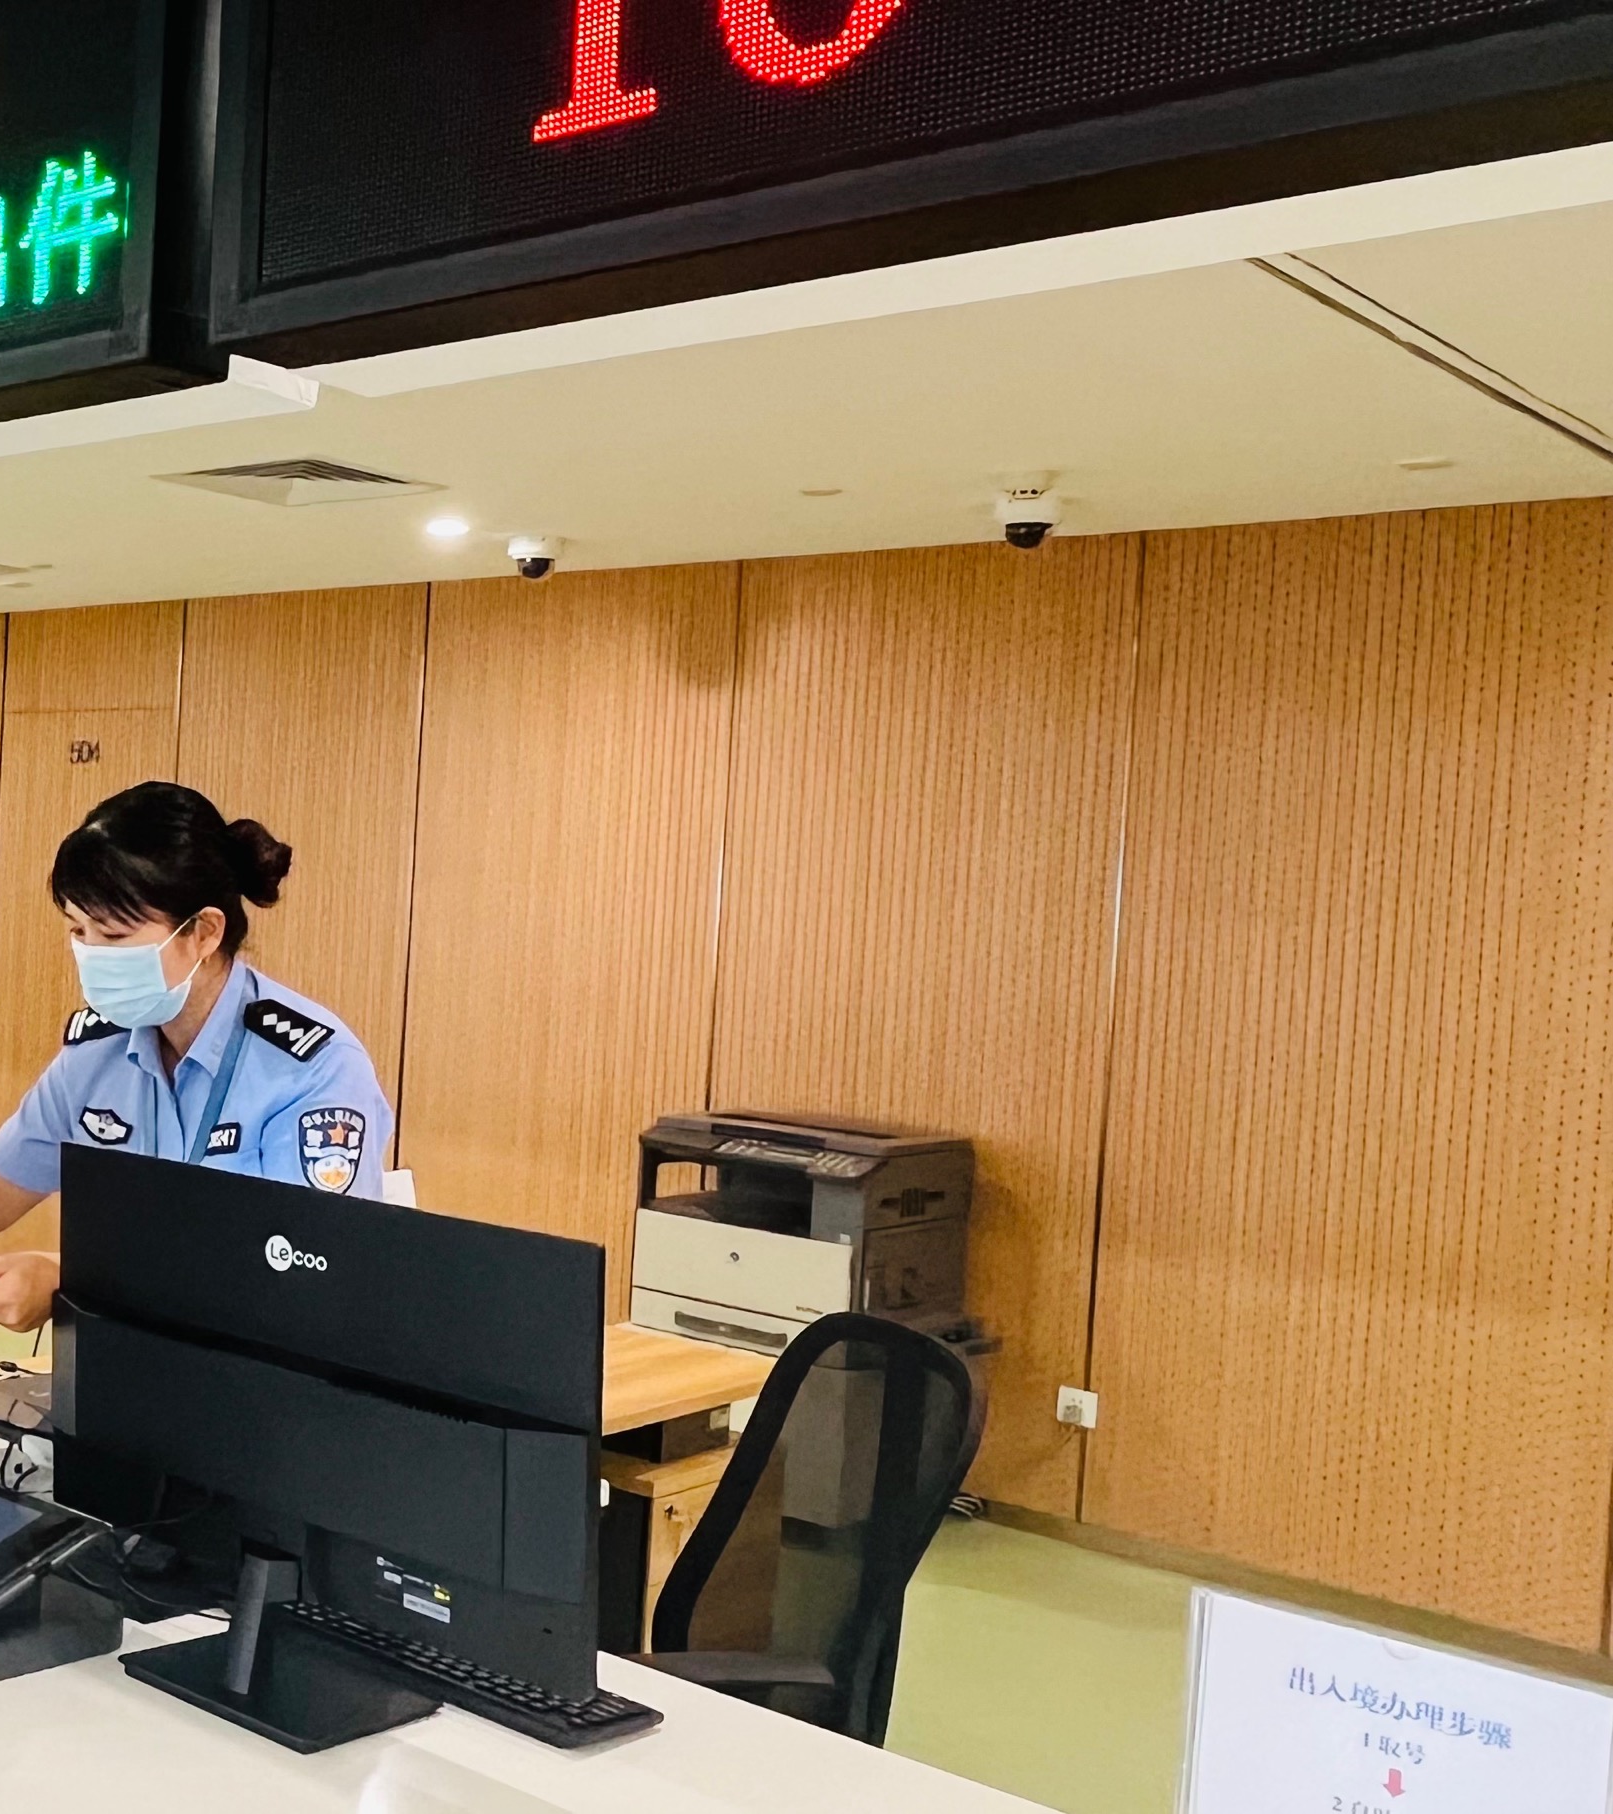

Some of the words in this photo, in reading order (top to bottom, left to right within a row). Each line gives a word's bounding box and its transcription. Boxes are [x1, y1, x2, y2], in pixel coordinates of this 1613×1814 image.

[267, 1236, 328, 1272] Lecoo
[1289, 1667, 1512, 1749] 出入境办理步骤
